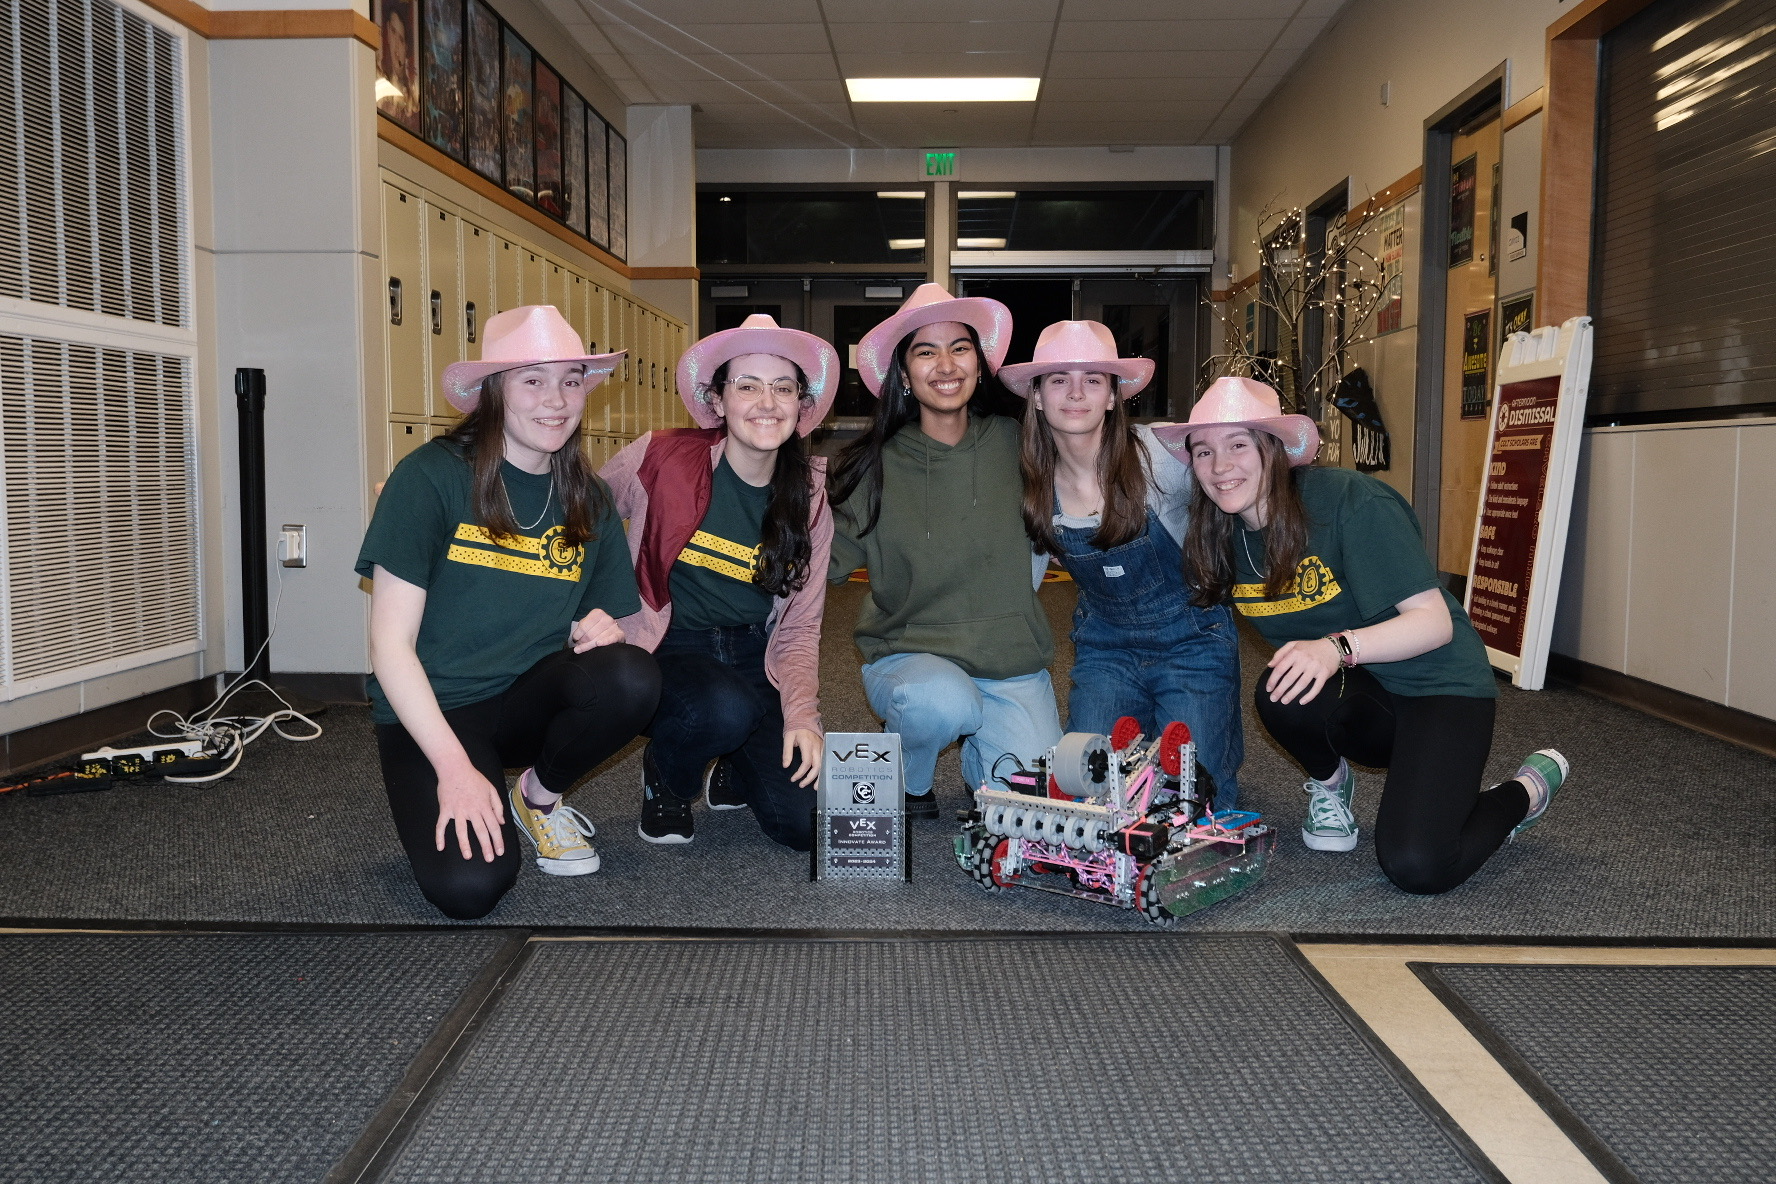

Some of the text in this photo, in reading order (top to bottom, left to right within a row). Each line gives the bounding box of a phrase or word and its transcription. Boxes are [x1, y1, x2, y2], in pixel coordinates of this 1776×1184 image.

[926, 153, 955, 175] EXIT
[1464, 385, 1484, 403] TODAY
[1512, 397, 1536, 407] AFTERNOON
[1509, 406, 1555, 425] DISMISSAL
[1530, 438, 1538, 446] ARE
[1489, 462, 1506, 475] KIND
[1480, 525, 1496, 540] SAFE
[1473, 575, 1518, 598] RESPONSIBLE
[832, 744, 891, 762] VEX
[850, 818, 876, 829] VEX
